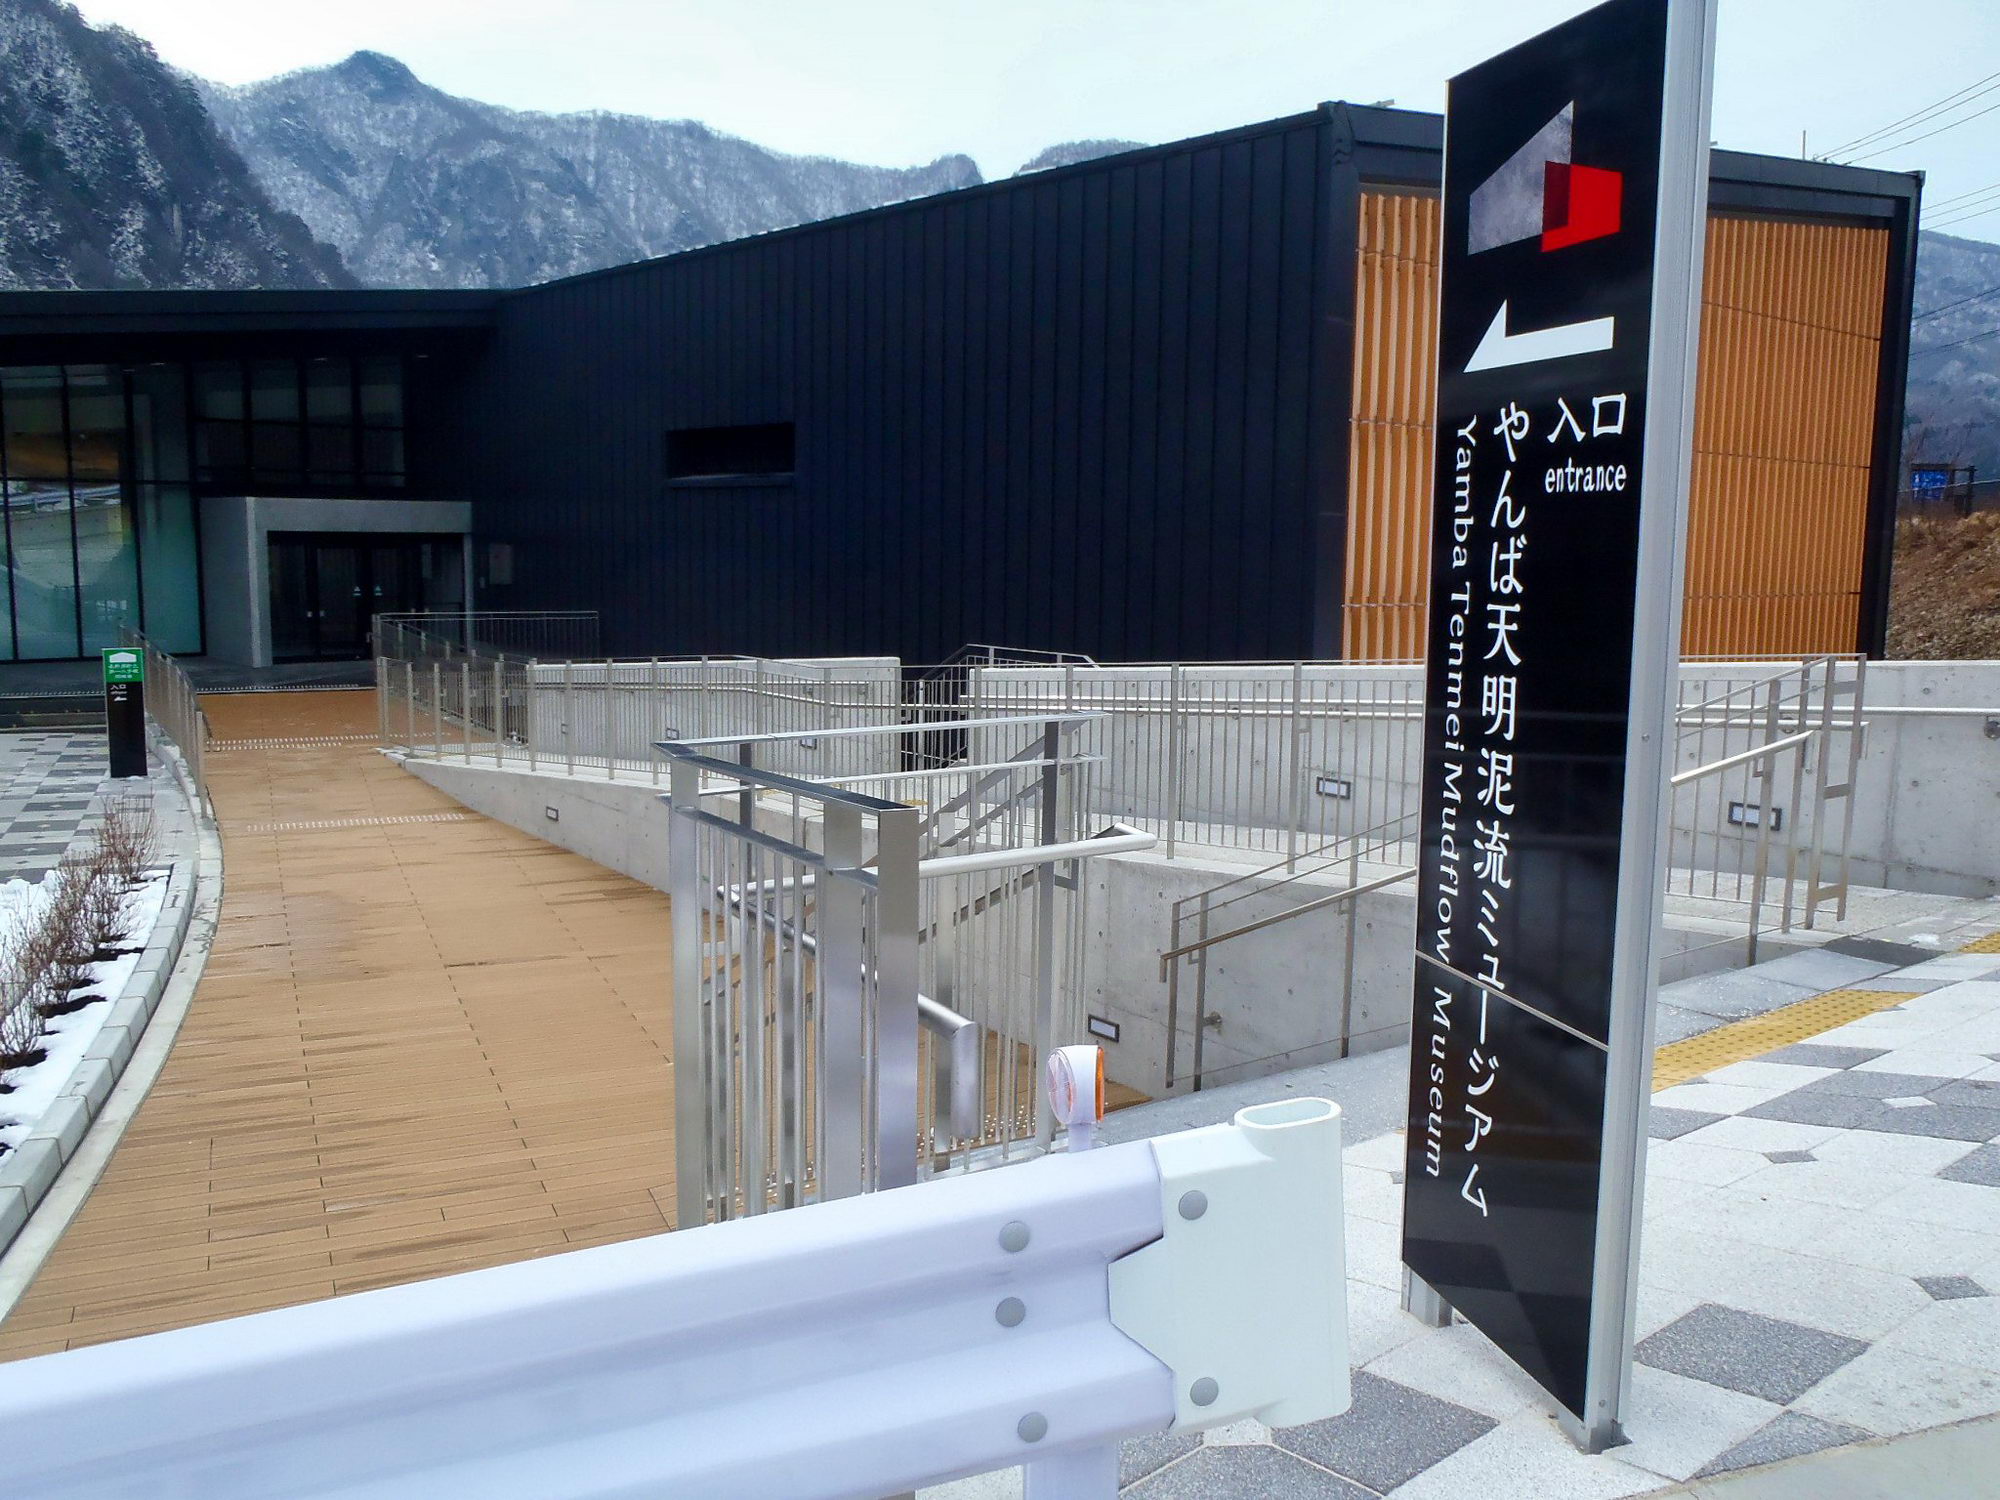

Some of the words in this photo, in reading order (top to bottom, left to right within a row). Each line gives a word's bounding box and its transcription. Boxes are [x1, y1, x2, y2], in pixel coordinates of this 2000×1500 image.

[1452, 414, 1477, 569] Yamba
[1545, 457, 1627, 494] entrance
[1546, 392, 1627, 443] 入口
[1444, 581, 1471, 752] Tenmei
[1436, 761, 1463, 964] Mudflow
[1461, 401, 1530, 1218] やんば天明泥流ミュージアム
[1425, 986, 1453, 1177] Museum
